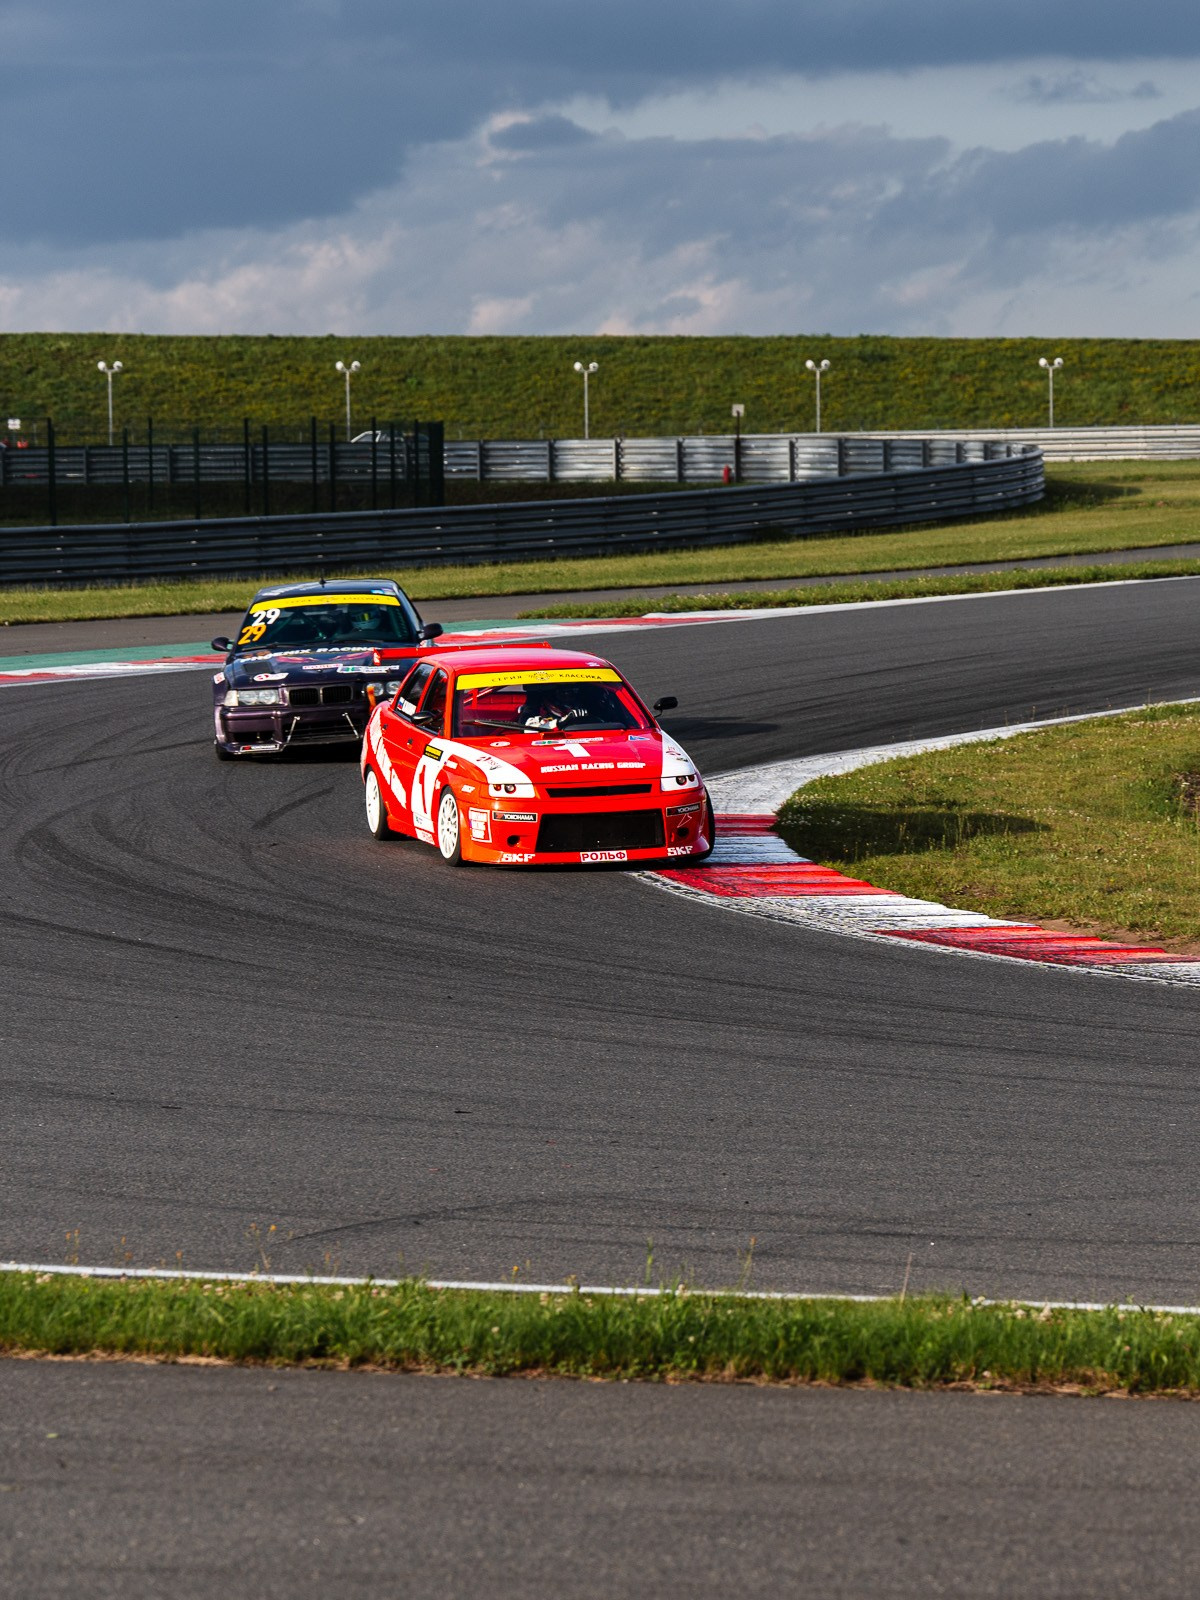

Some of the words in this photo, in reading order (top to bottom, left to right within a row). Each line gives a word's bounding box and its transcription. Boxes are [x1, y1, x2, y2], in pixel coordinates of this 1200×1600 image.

[251, 608, 280, 626] 29
[237, 624, 267, 645] 29
[540, 764, 579, 773] RUSSIAN
[581, 762, 615, 770] RACING
[582, 851, 627, 862] РОЛЬФ
[667, 845, 694, 857] SKF
[501, 852, 536, 863] SKF
